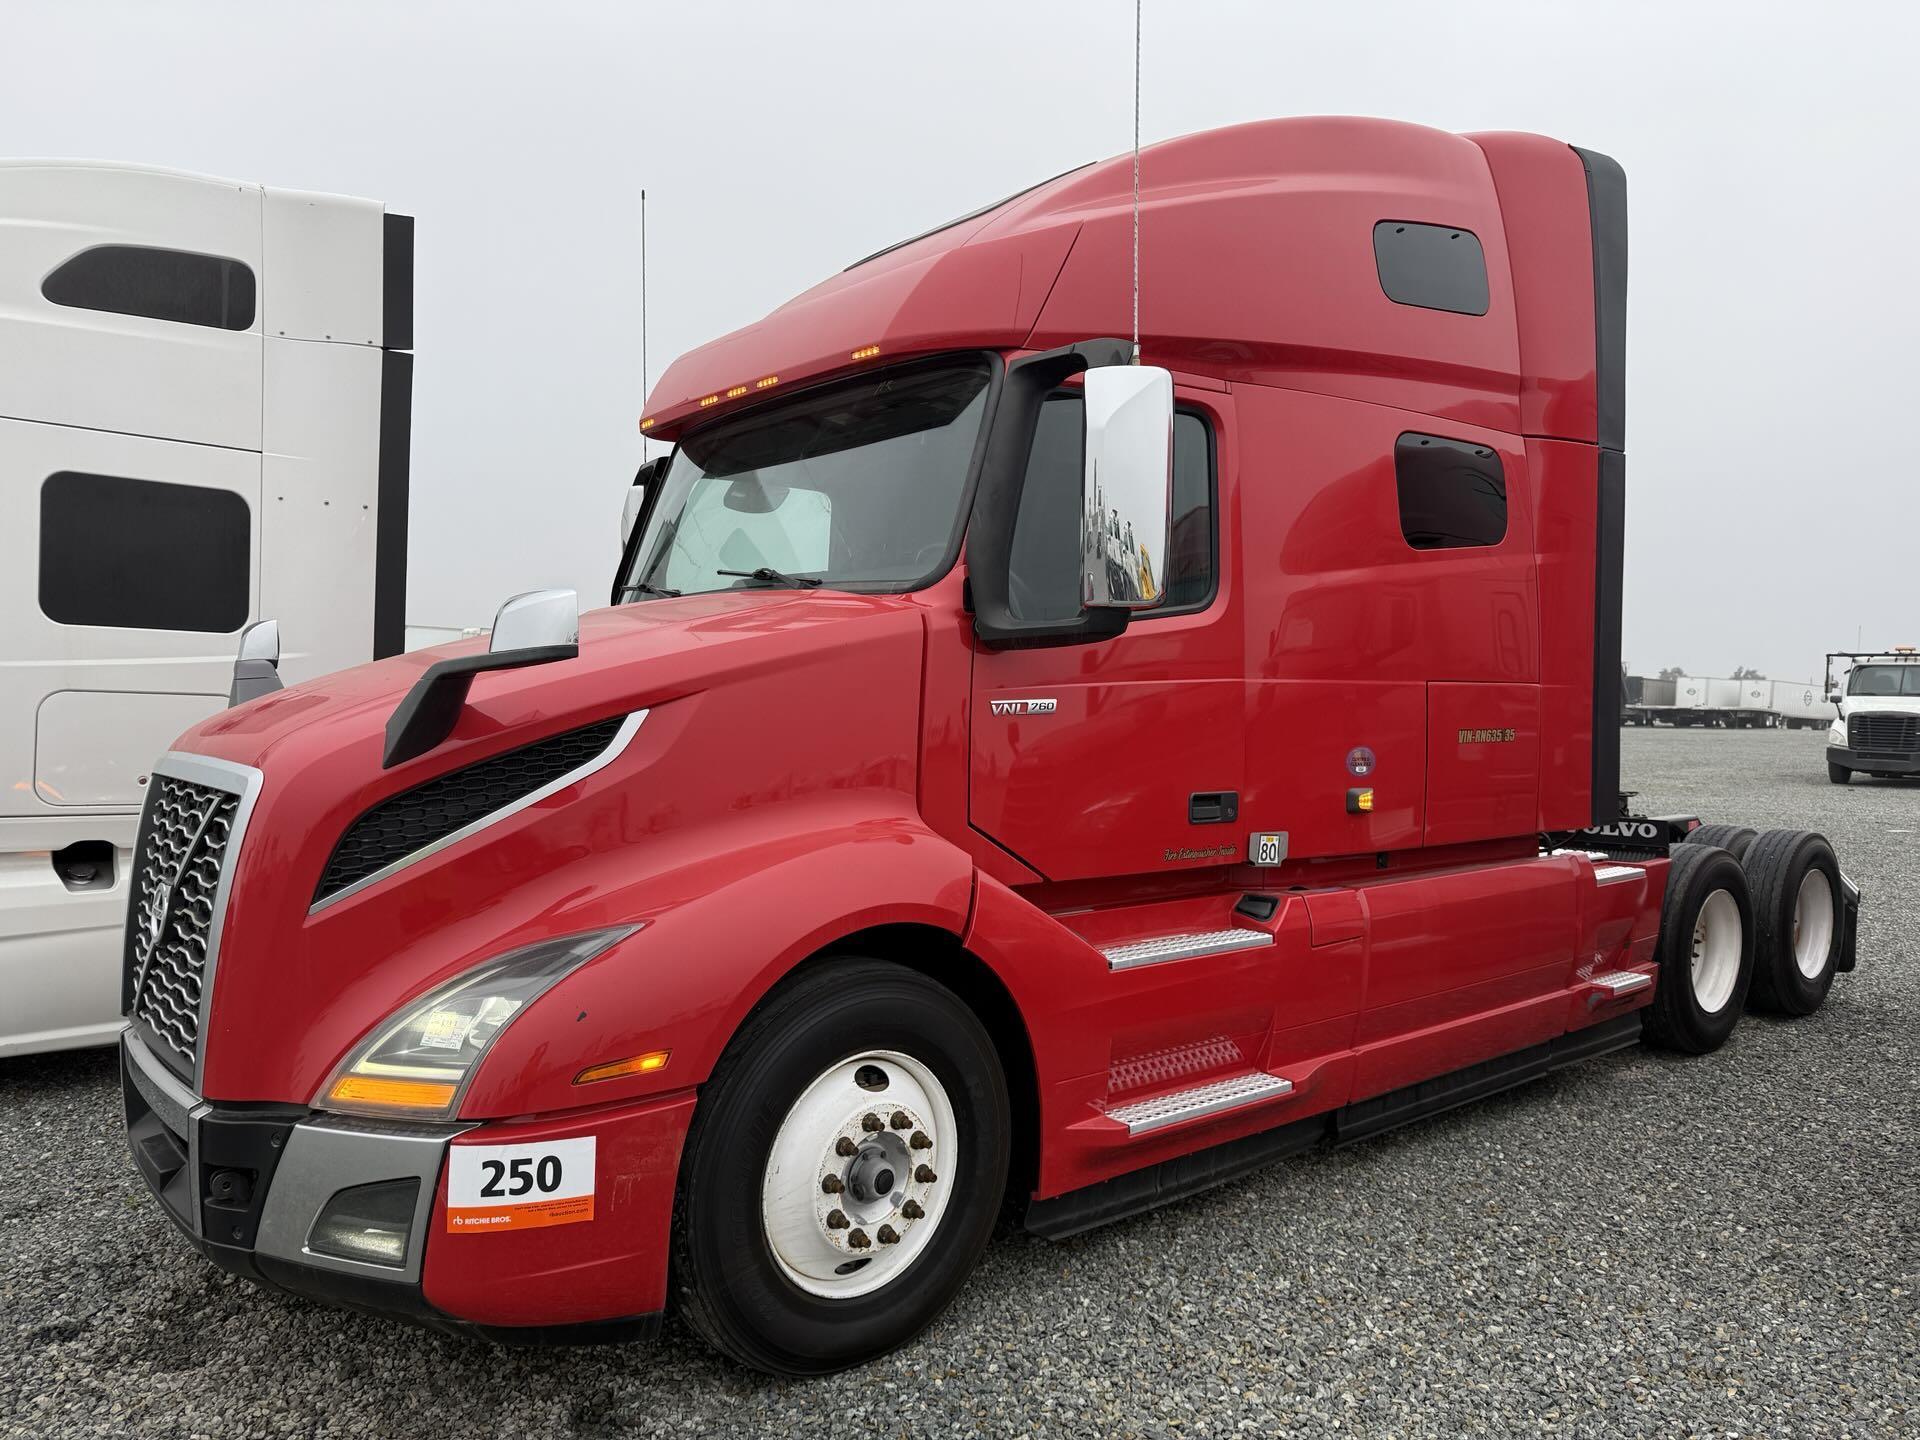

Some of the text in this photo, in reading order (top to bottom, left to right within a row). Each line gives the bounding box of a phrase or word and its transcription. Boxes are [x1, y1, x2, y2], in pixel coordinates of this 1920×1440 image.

[991, 702, 1055, 716] VNL 760
[1567, 821, 1658, 838] OLVO
[1260, 843, 1277, 862] 80
[480, 1155, 563, 1198] 250
[453, 1215, 464, 1225] rb
[464, 1216, 490, 1225] RITCHIE
